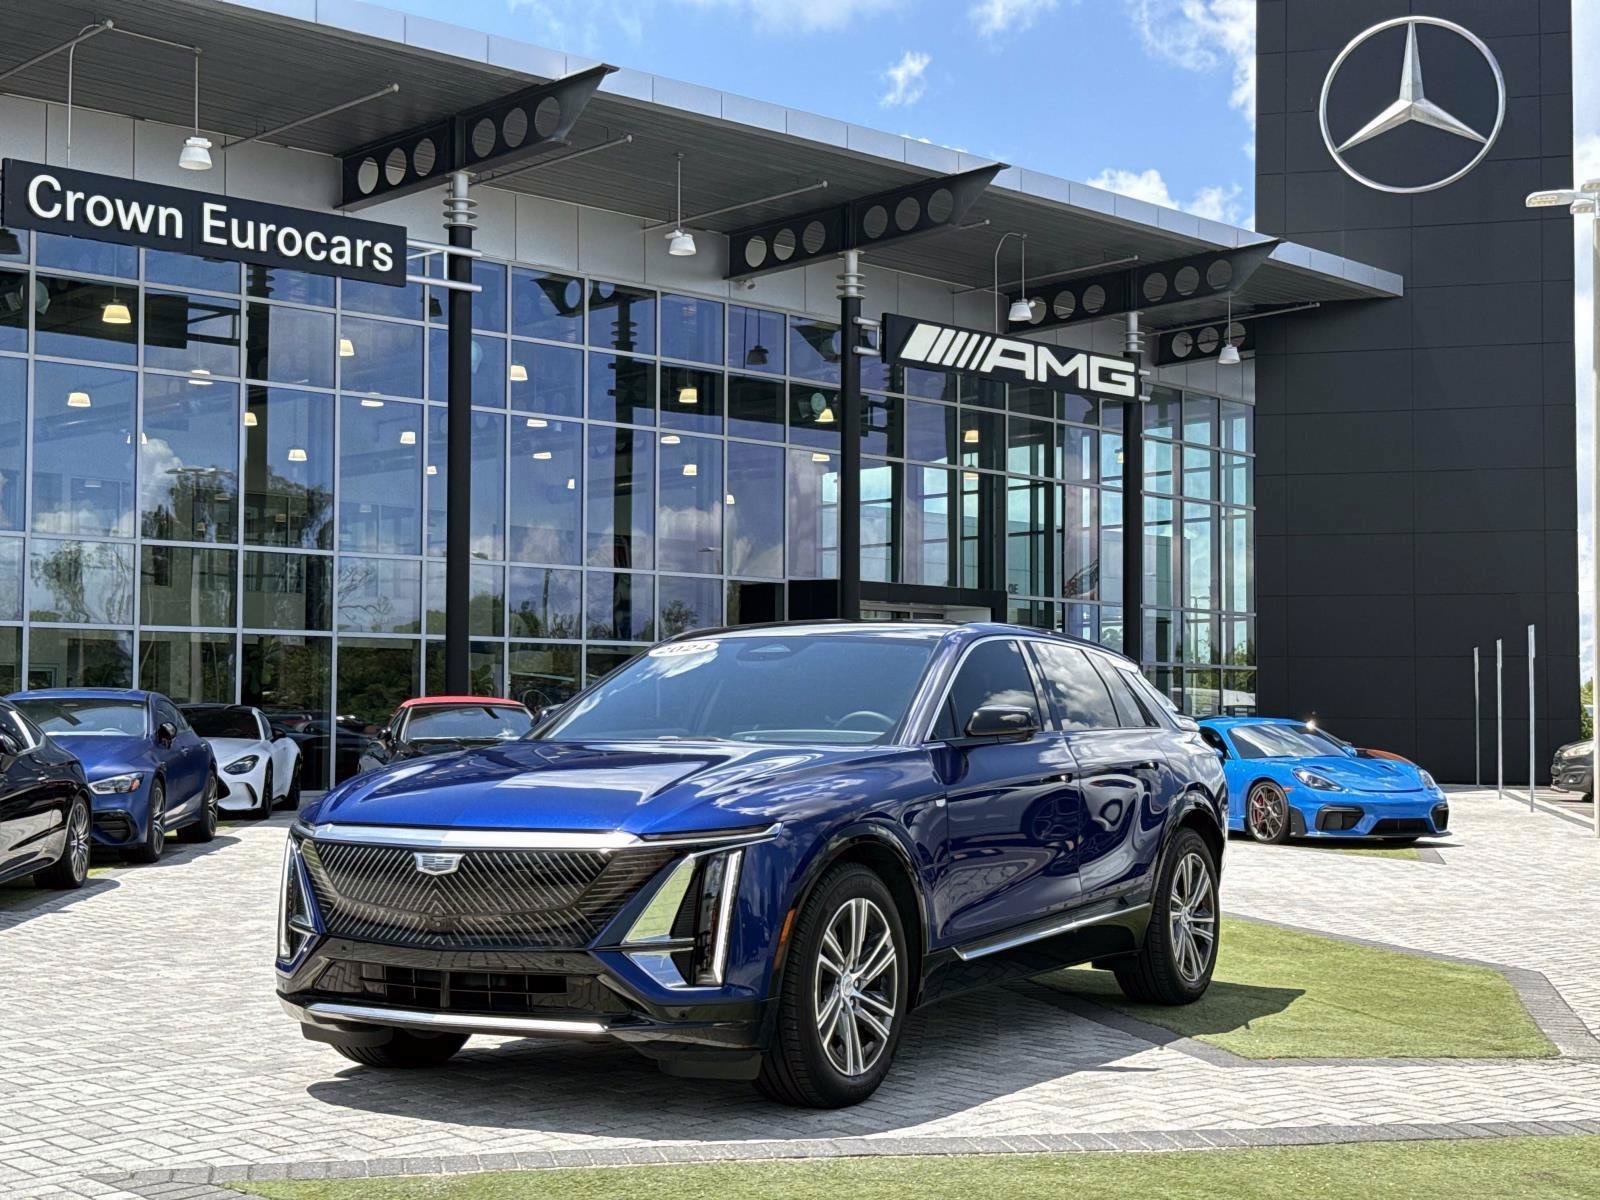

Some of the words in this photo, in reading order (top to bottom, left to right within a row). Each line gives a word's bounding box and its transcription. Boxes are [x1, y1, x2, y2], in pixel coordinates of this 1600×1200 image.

[28, 174, 183, 239] Crown
[202, 202, 394, 272] Eurocars
[980, 338, 1135, 397] AMG
